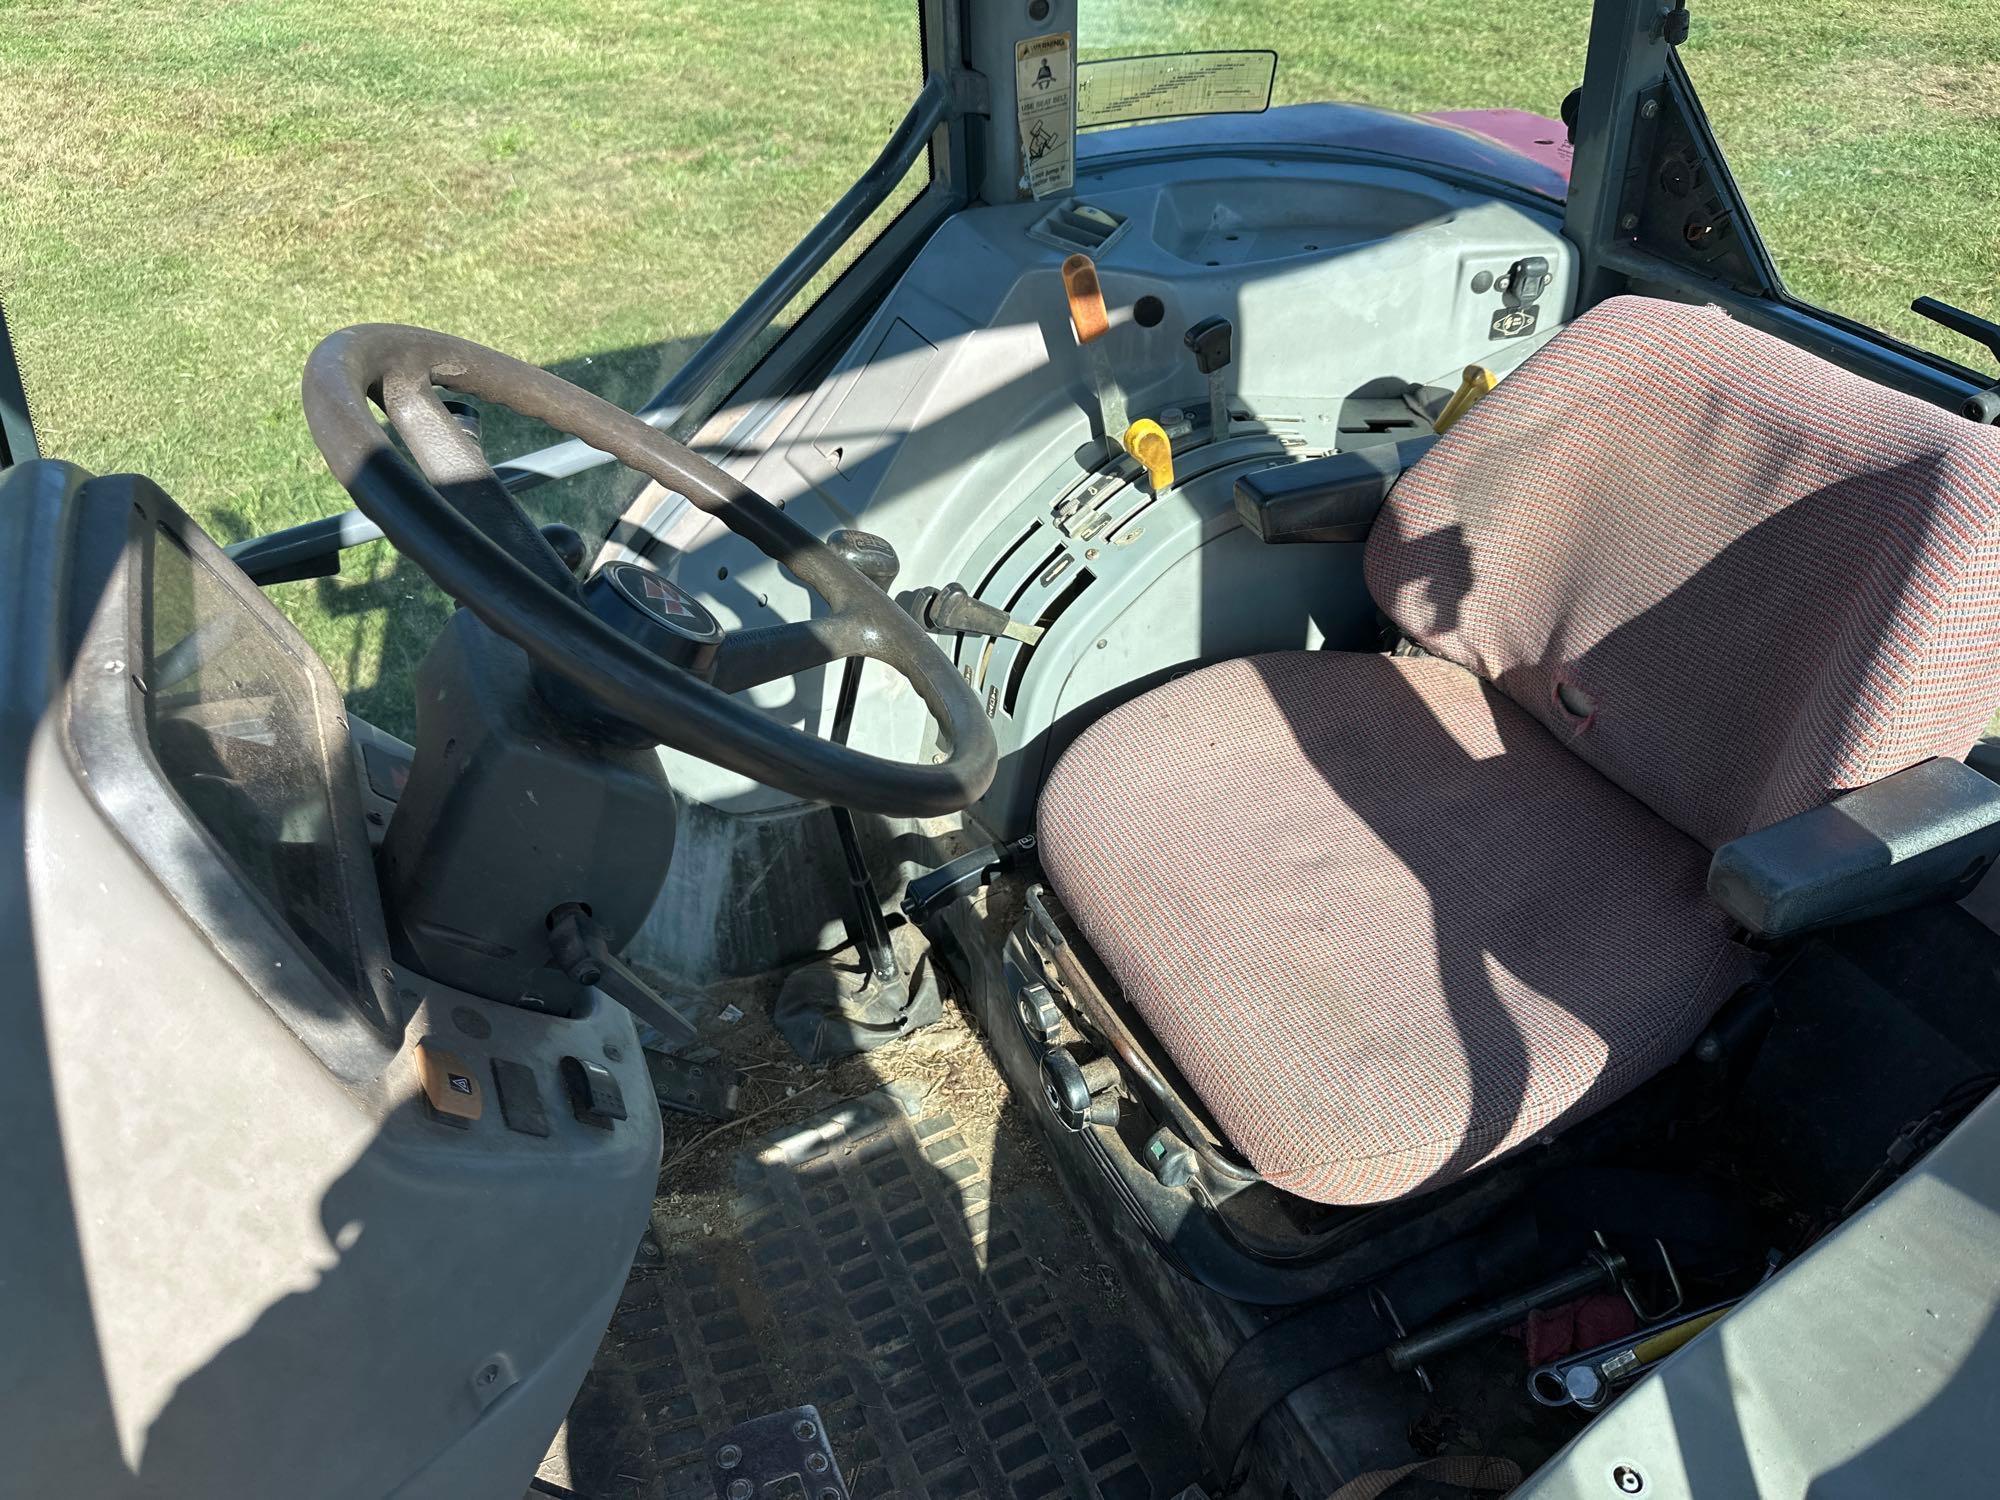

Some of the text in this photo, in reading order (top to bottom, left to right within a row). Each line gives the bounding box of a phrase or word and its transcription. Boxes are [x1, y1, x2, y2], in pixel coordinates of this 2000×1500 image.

[1021, 103, 1034, 112] USE
[1035, 98, 1051, 108] SEAT
[1053, 94, 1068, 103] BELT
